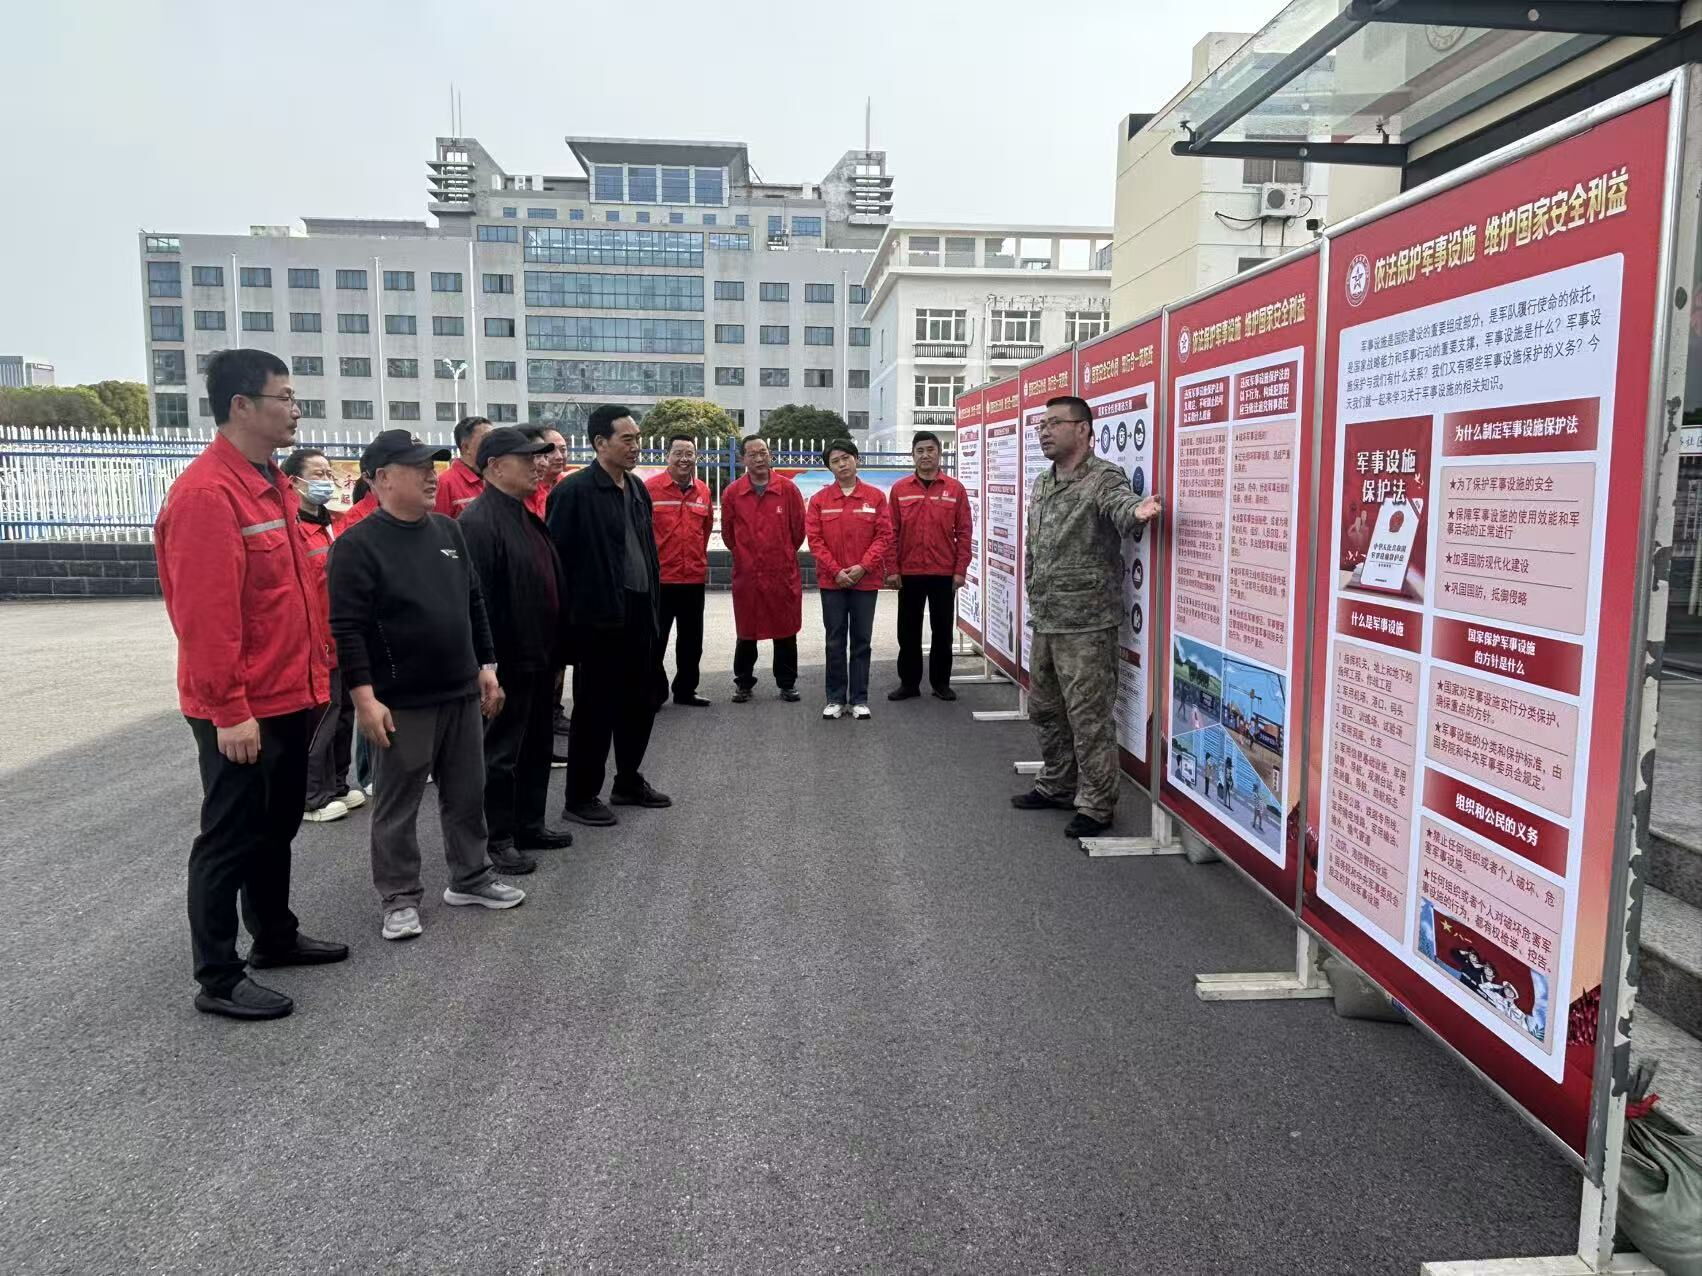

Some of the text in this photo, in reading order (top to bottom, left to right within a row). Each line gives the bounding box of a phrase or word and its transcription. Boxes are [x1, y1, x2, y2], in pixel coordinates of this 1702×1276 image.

[1374, 224, 1477, 293] 依法保护军事设施
[1484, 167, 1629, 256] 维护国家安全利益
[1245, 293, 1306, 338] 维护国家安全利益
[1454, 415, 1580, 442] 为什么制定军事设施保护法
[1356, 448, 1417, 475] 军事设施
[1362, 479, 1408, 505] 保护法
[1446, 522, 1514, 540] 事活动的正常进行
[1452, 553, 1530, 574] 加强国防现代化建设
[1351, 611, 1404, 637] 什么是军事设施
[1467, 628, 1536, 657] 国家保护军事设施
[1474, 650, 1526, 675] 的方针是什么
[1455, 793, 1539, 847] 组织和公民的义务
